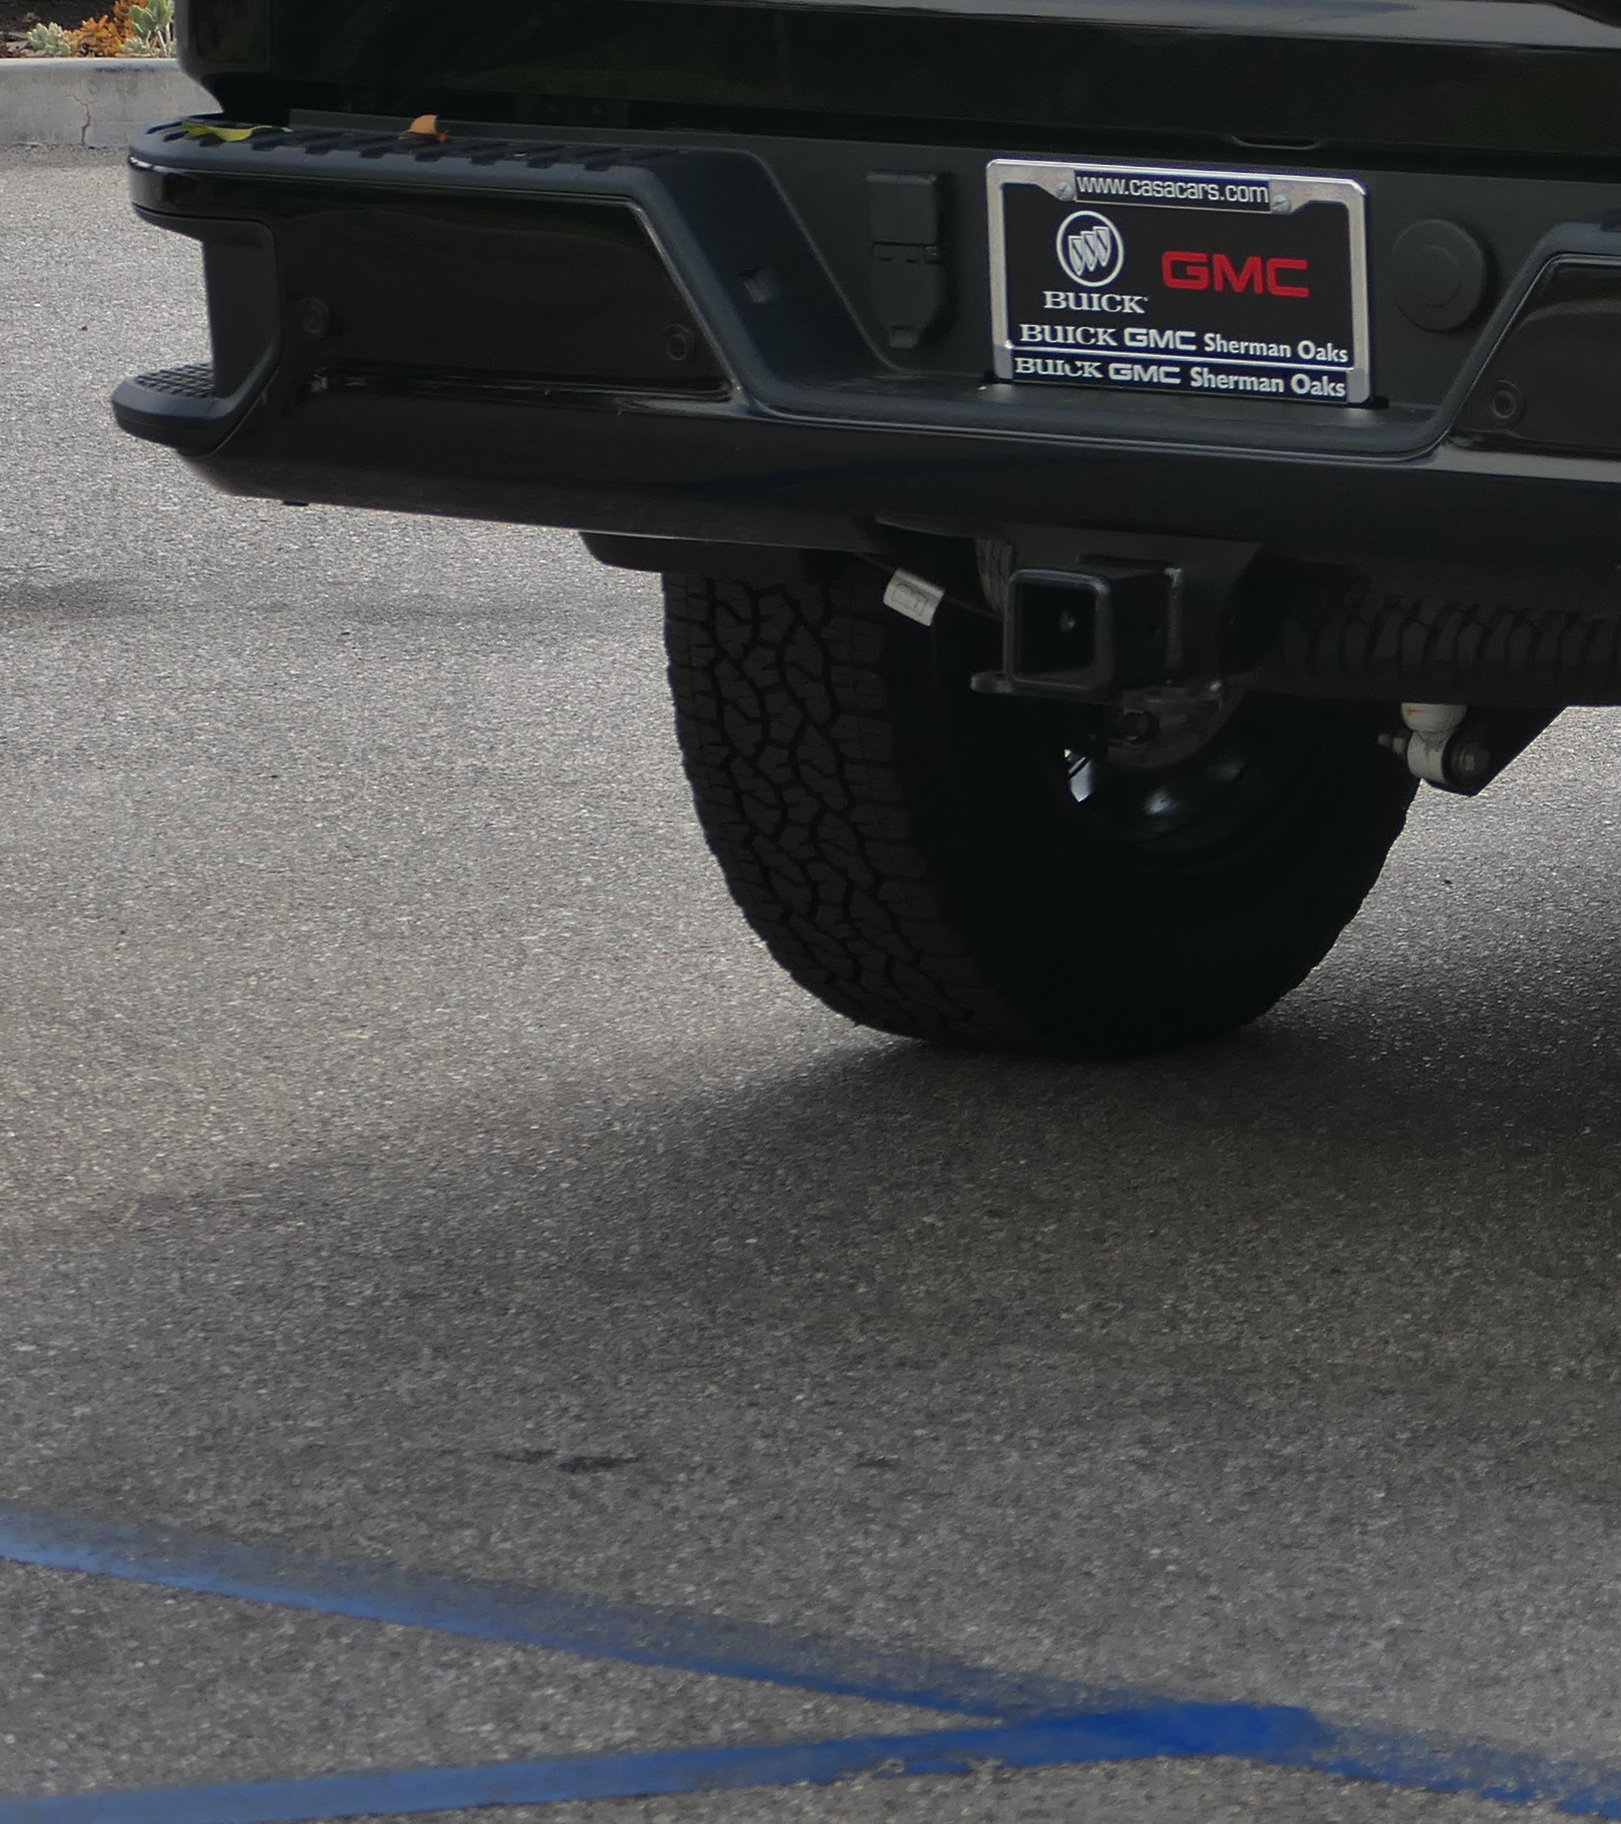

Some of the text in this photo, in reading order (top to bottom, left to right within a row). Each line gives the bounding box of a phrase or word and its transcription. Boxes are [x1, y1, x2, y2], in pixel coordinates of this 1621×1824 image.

[1076, 176, 1269, 204] www.casacars.com
[1161, 250, 1311, 298] GMC
[1043, 290, 1146, 315] BUICK
[1019, 323, 1349, 363] BUICK GMC Sherman Oaks
[1014, 357, 1346, 398] BUICK GMC Sherman Oaks
